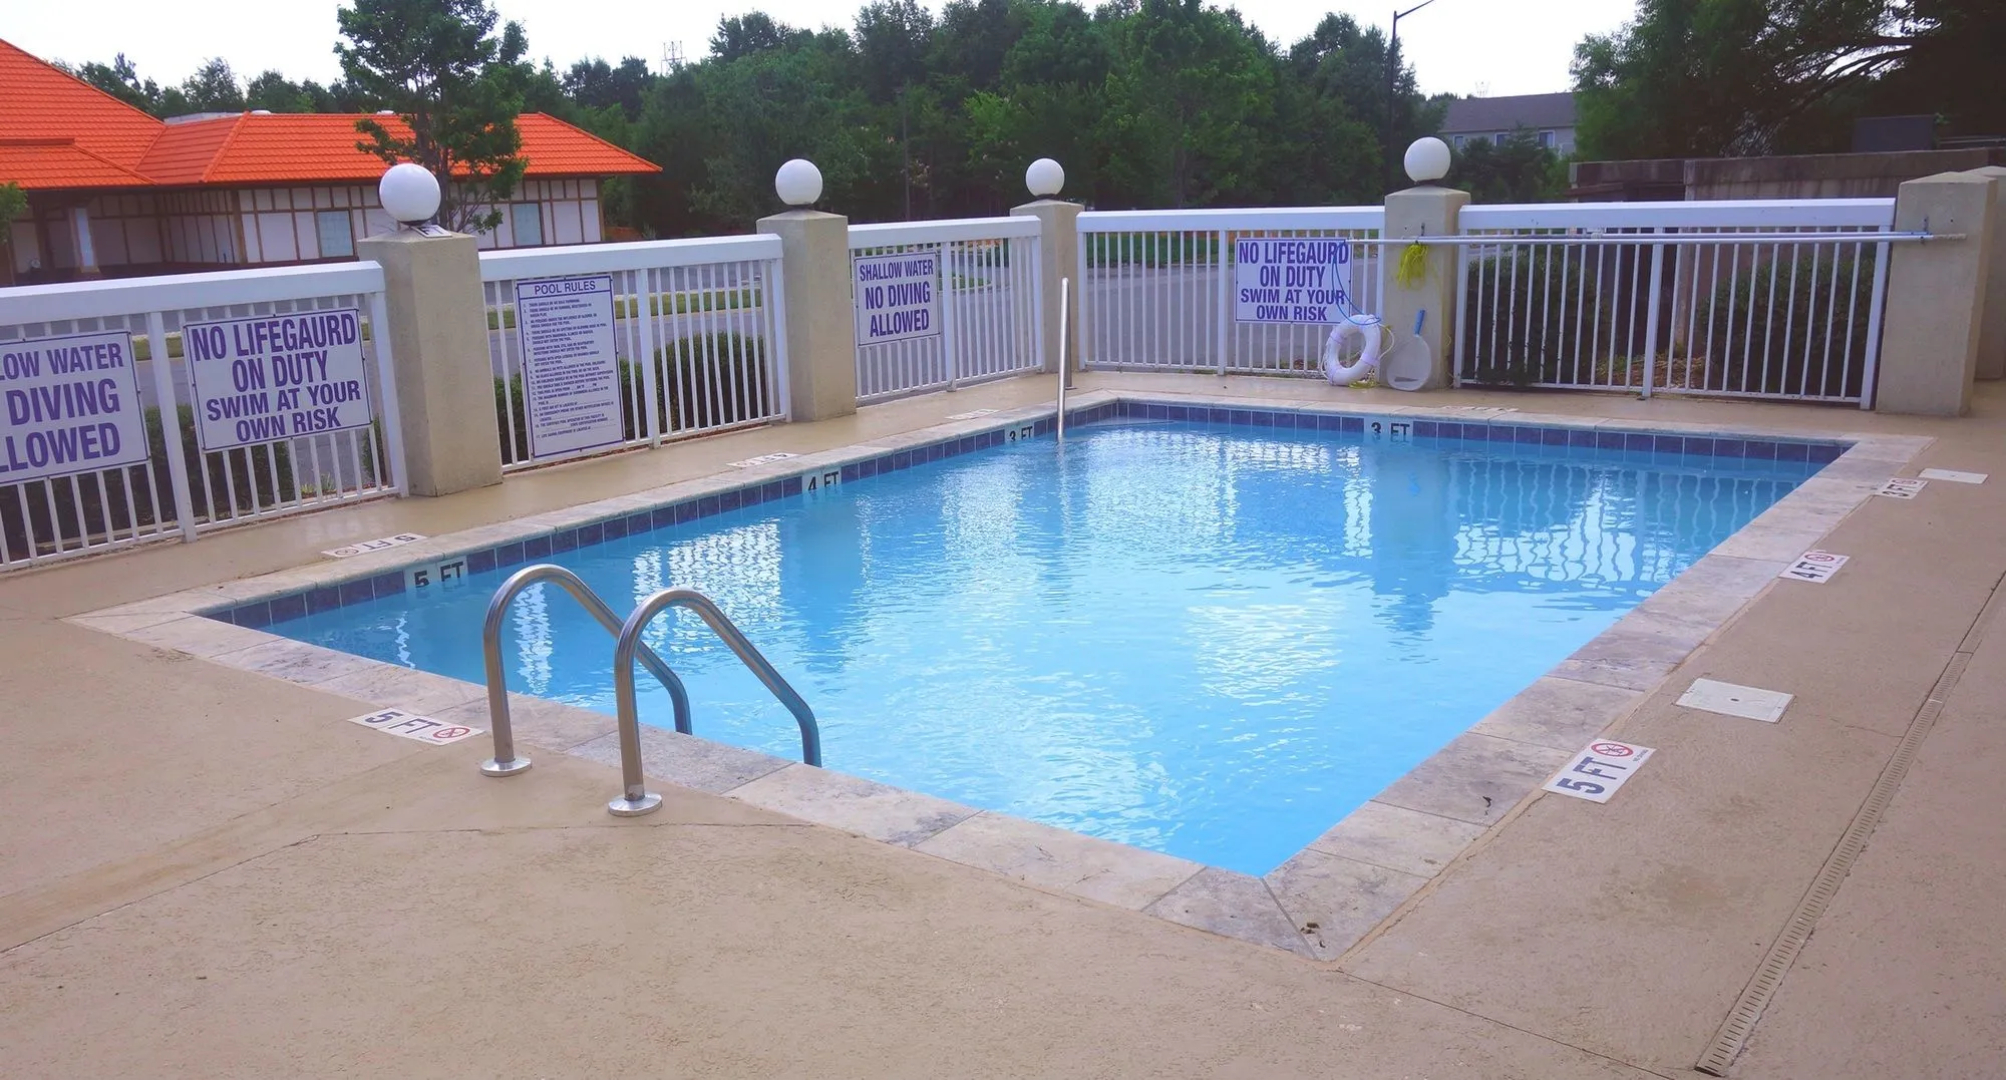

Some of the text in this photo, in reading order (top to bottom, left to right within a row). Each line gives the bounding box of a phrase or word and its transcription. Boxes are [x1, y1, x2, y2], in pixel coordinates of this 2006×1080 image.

[1239, 242, 1349, 264] NO LIFEGAURD
[860, 259, 933, 281] SHALLOW WATER
[1260, 266, 1325, 287] ON DUTY
[534, 281, 596, 295] POOL RULES
[865, 281, 931, 310] NO DIVING
[1241, 288, 1345, 305] SWIM AT YOUR
[870, 309, 929, 337] ALLOWED
[1256, 305, 1327, 321] OWN RISK
[191, 313, 356, 361] NO LIFEGAURD
[0, 343, 124, 381] OW WATER
[232, 350, 327, 392] ON DUTY
[5, 378, 120, 426] DIVING
[206, 380, 361, 421] SWIM AT YOUR
[236, 407, 341, 442] OWN RISK
[1009, 426, 1033, 442] 3 FT
[1371, 422, 1410, 436] 3 FT
[808, 471, 839, 491] 4 FT
[414, 561, 464, 588] 5 FT
[1790, 570, 1824, 579] 4
[365, 711, 442, 734] 5 FT
[1556, 756, 1627, 794] 5 FT
